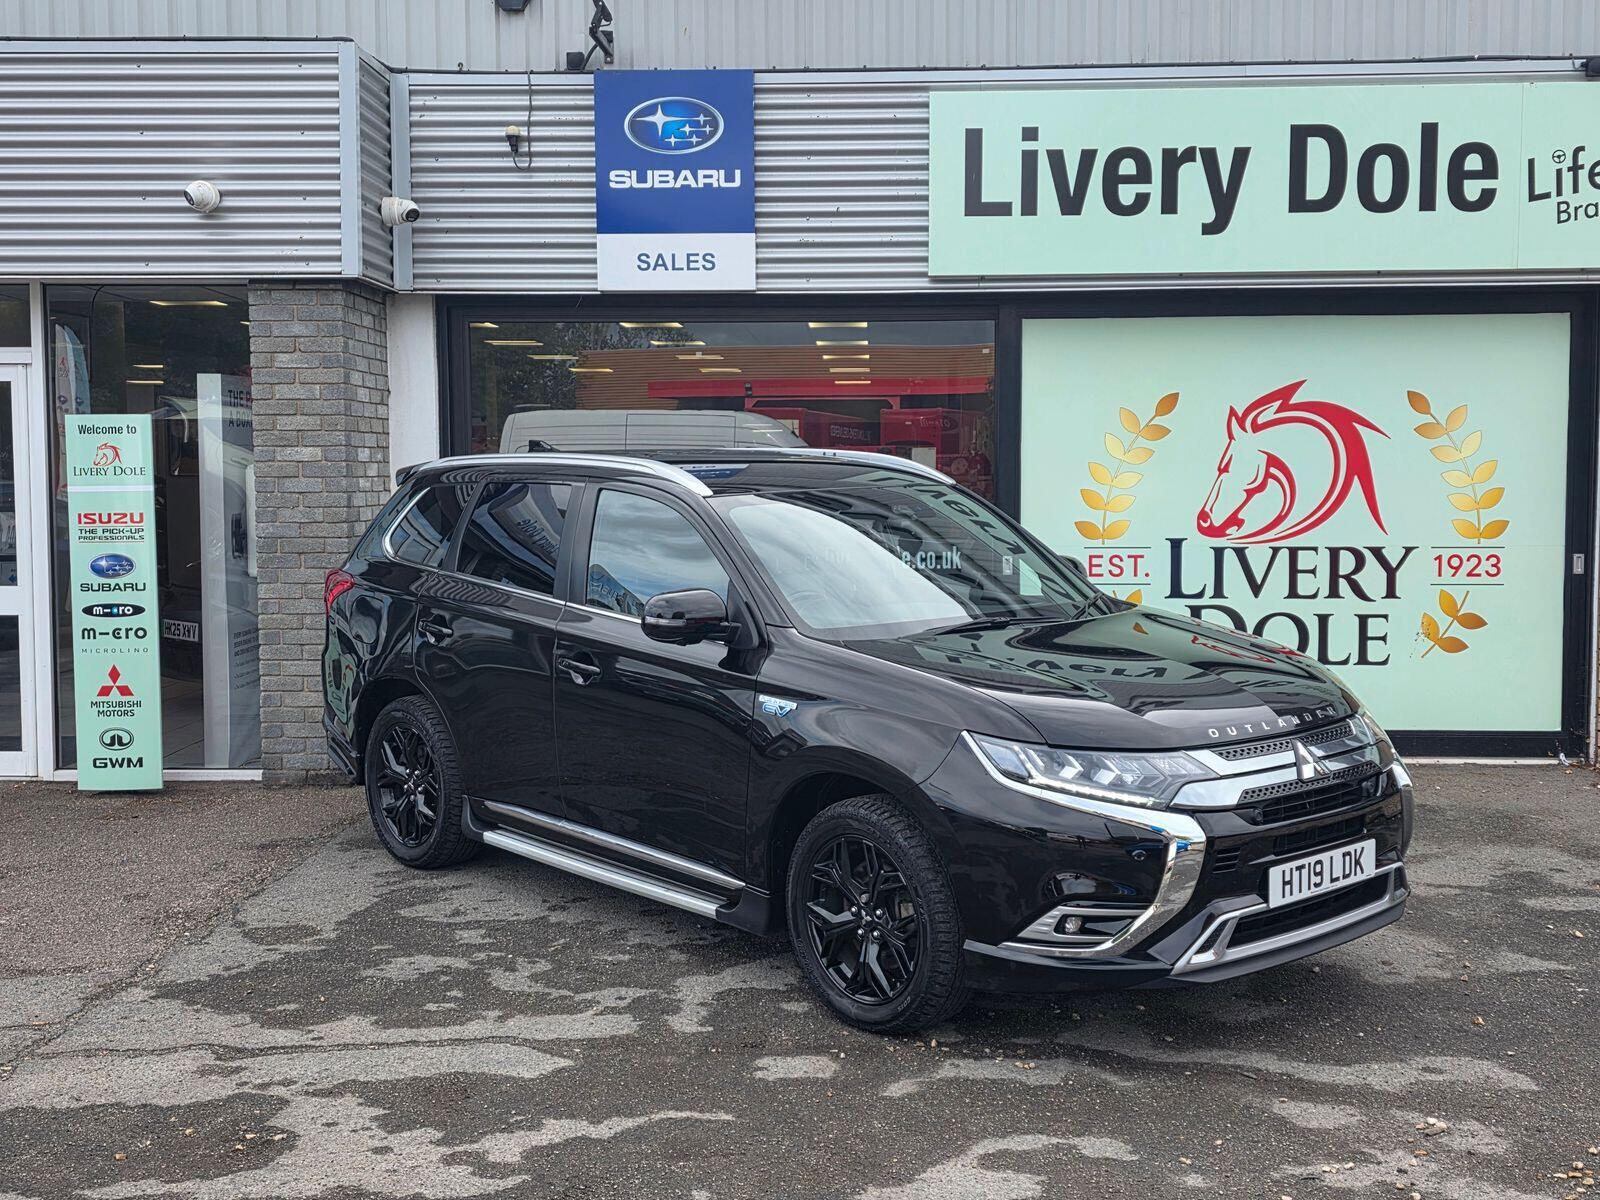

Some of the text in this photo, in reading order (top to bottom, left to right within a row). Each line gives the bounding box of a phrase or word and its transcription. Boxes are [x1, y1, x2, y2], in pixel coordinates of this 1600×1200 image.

[609, 169, 741, 189] SUBARU
[963, 121, 1500, 236] Livery Dole
[636, 252, 716, 271] SALES
[77, 424, 137, 435] Welcome to
[73, 465, 146, 477] LIVERY DOLE
[77, 512, 144, 525] ISUZU
[102, 527, 145, 535] PICK-UP
[1087, 553, 1150, 578] EST.
[1164, 537, 1419, 602] LIVERY
[1432, 553, 1502, 578] 1923
[80, 582, 147, 592] SUBARU
[90, 700, 142, 709] MITSUBISHI
[97, 709, 135, 717] MOTORS
[1208, 706, 1337, 738] OUTLANDER
[92, 756, 144, 769] GWM
[1281, 846, 1365, 899] HT19 LDK
